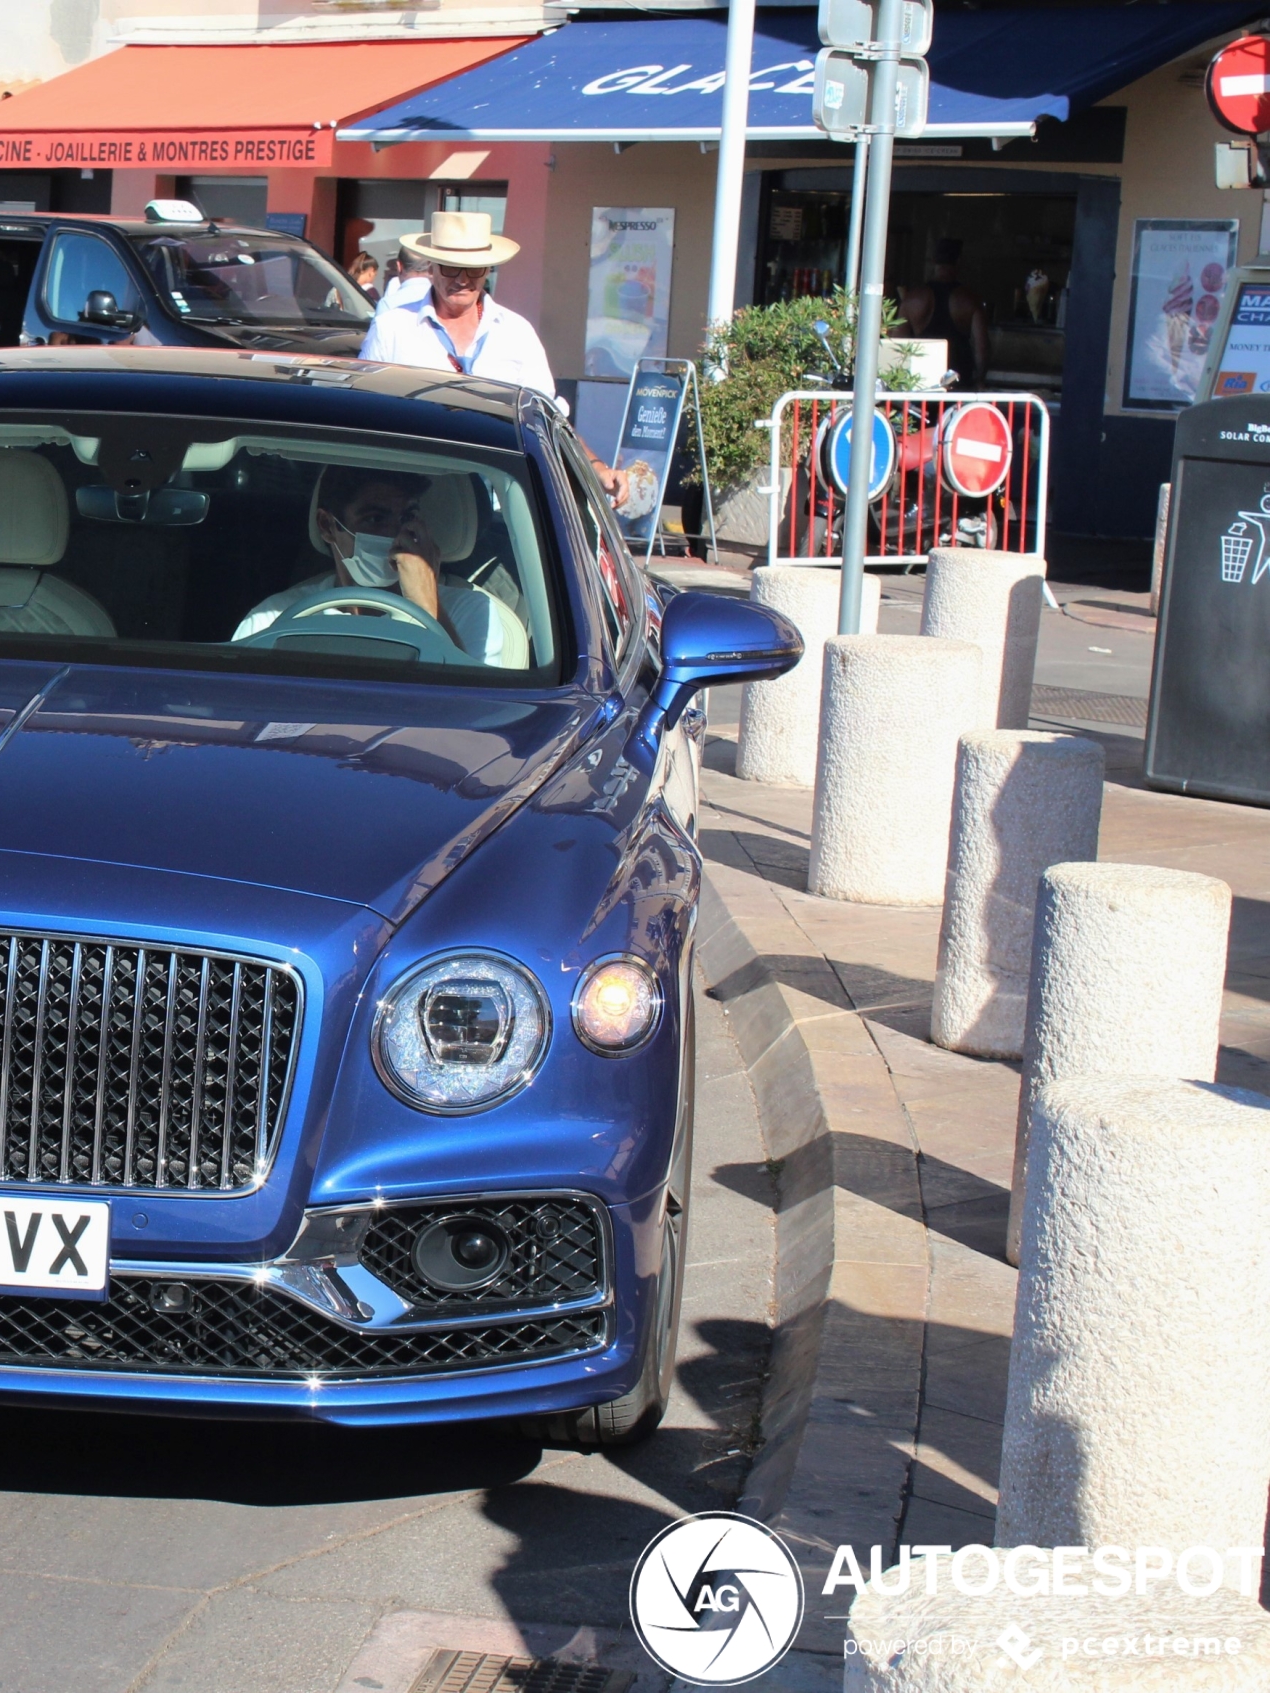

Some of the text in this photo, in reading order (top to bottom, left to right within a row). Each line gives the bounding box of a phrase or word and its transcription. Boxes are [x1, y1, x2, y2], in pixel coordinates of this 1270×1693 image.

[45, 142, 133, 162] JOAILLERIE
[137, 142, 147, 162] &
[152, 140, 229, 162] MONTRES
[234, 139, 315, 161] PRESTIGE
[609, 220, 657, 231] NESPRESSO
[636, 386, 678, 399] MÖVENPICK
[1220, 431, 1250, 442] SOLAR
